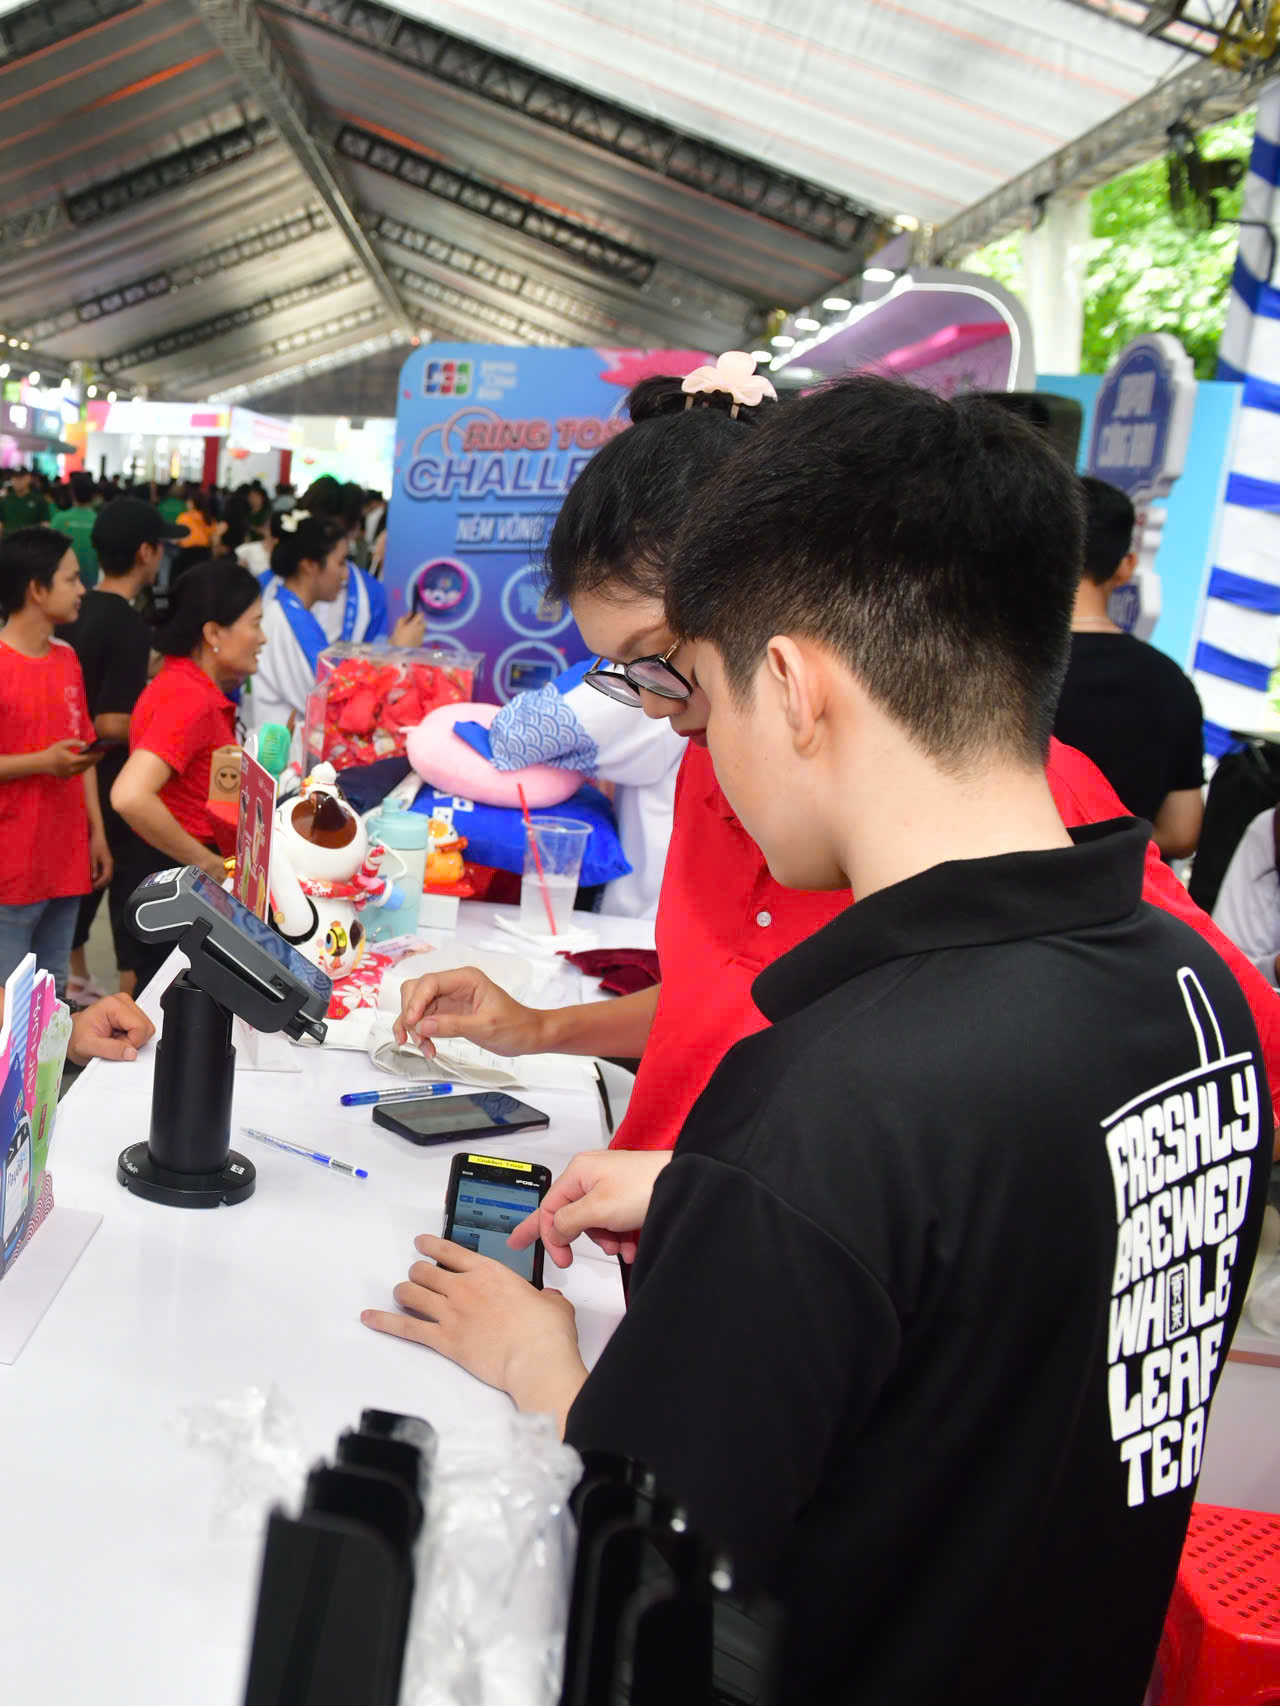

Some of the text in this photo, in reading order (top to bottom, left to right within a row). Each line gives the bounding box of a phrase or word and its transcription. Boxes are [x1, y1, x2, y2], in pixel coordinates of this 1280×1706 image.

[464, 419, 552, 452] RING
[8, 1159, 24, 1187] Payoo
[1105, 1064, 1260, 1225] FRESHLY
[1111, 1156, 1252, 1297] BREWED
[1107, 1234, 1239, 1366] WHOLE
[1107, 1320, 1225, 1443] LEAF
[1120, 1406, 1205, 1508] TEA
